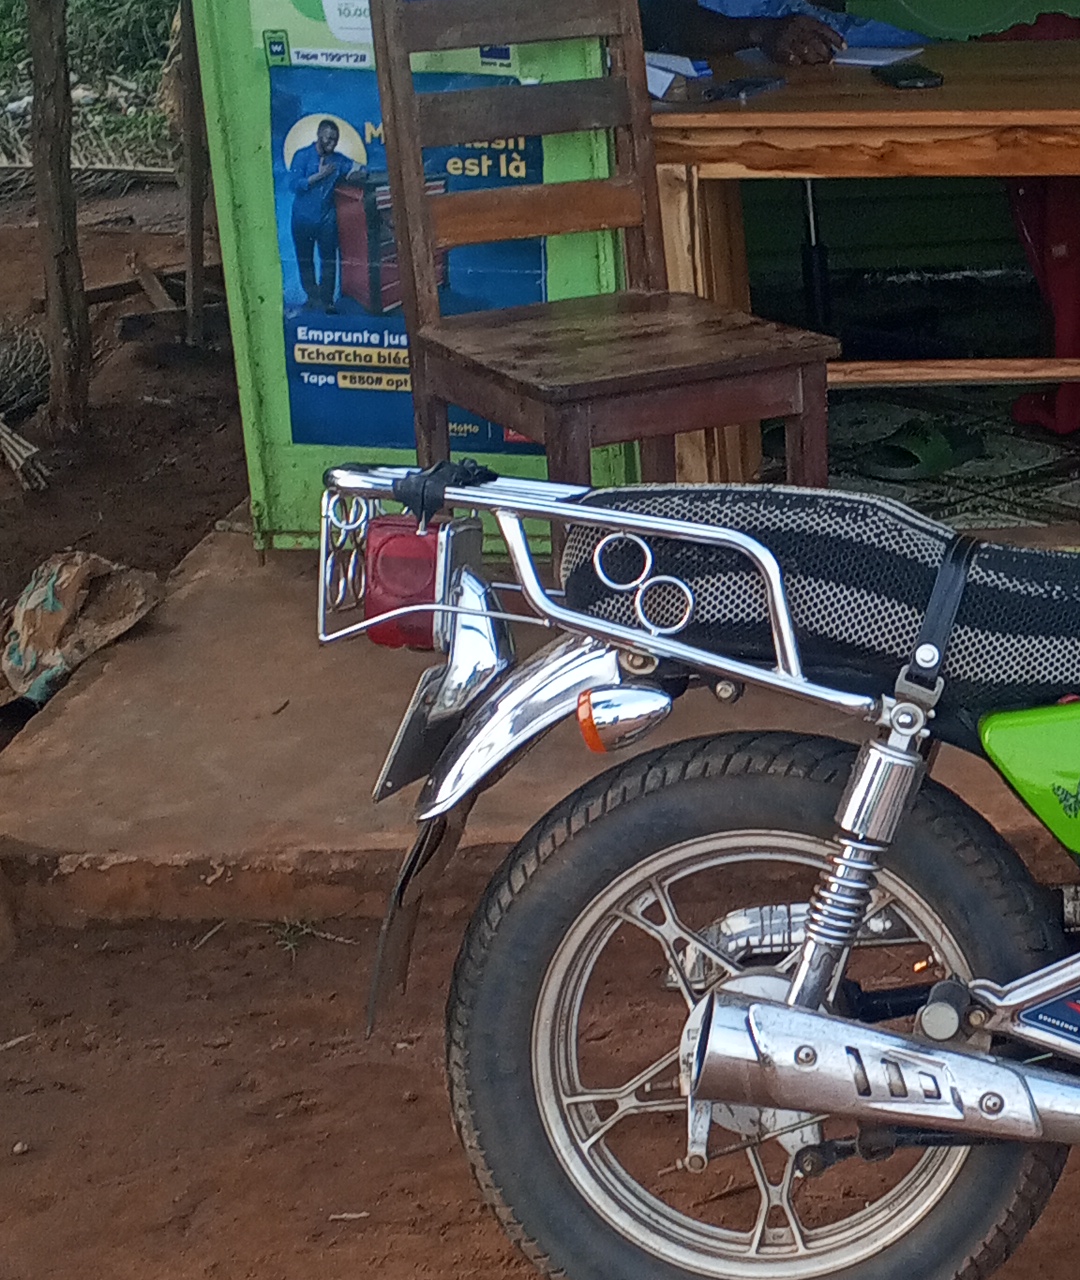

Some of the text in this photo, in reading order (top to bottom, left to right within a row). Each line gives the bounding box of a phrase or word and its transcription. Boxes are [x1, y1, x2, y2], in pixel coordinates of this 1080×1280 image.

[338, 7, 369, 18] 10.00
[294, 50, 319, 60] Tape
[446, 152, 526, 178] est là
[297, 326, 408, 347] Emprunte jus
[298, 348, 373, 364] TchaTcha
[300, 372, 335, 387] Tape
[386, 376, 408, 390] opt
